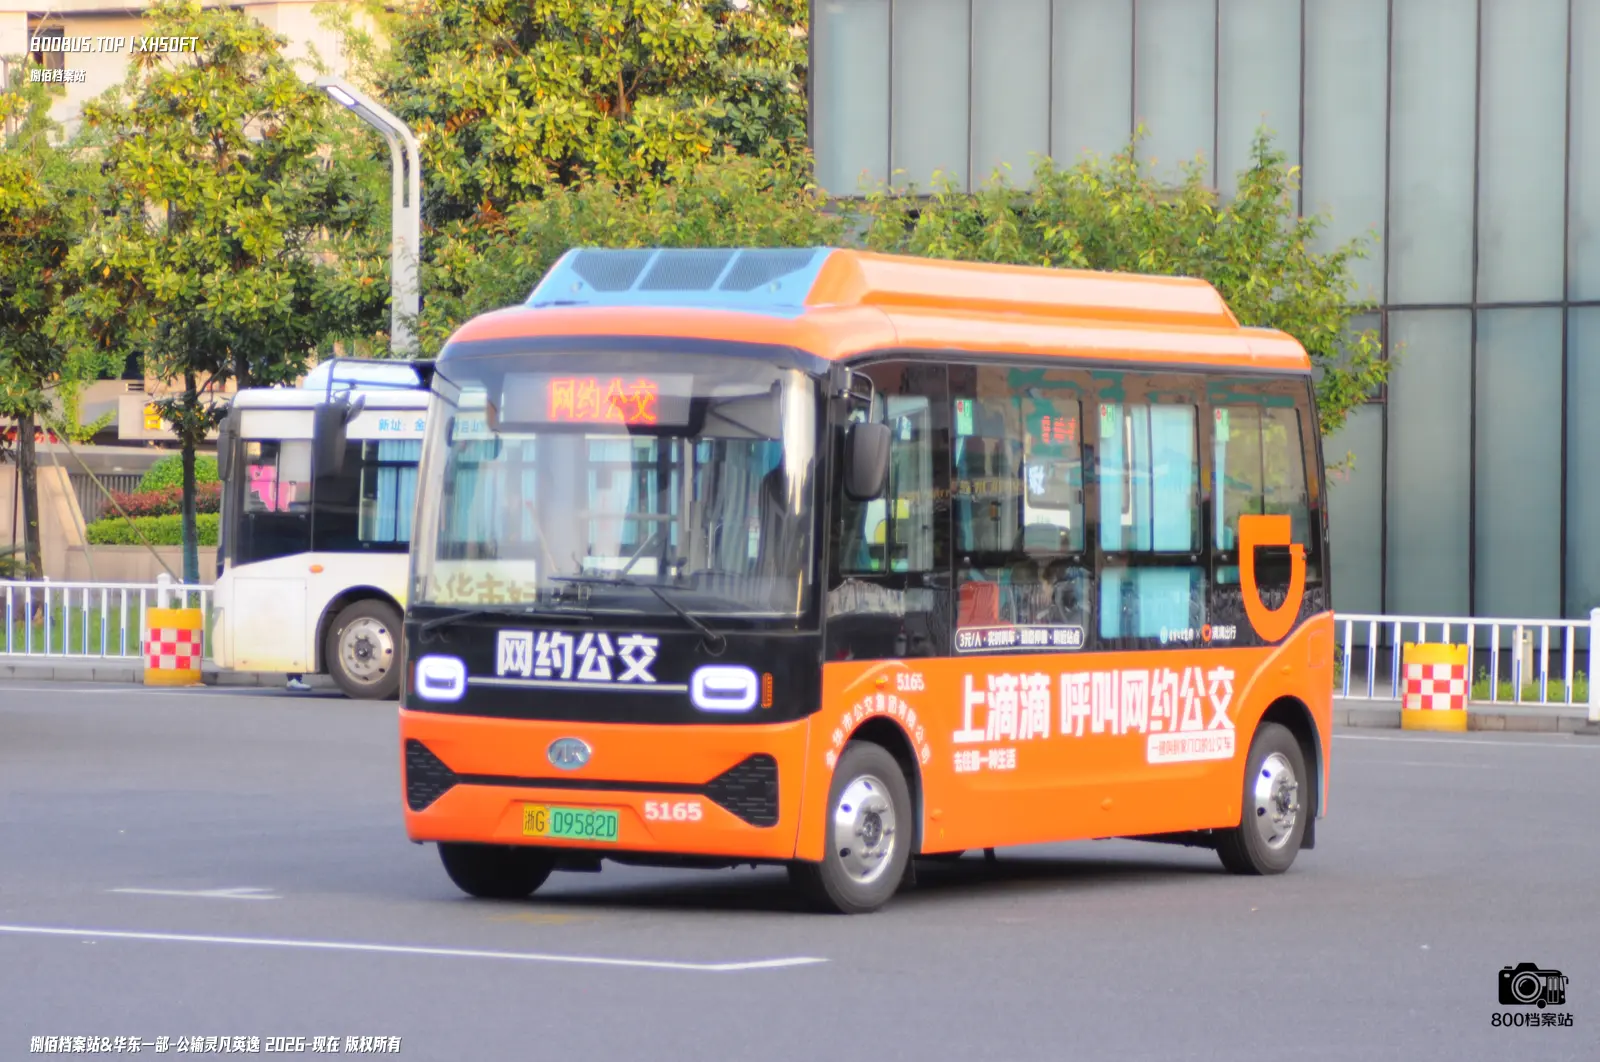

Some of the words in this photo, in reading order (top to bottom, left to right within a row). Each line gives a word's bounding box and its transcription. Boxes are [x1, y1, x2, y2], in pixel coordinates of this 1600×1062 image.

[550, 378, 658, 423] 网约公交
[496, 630, 659, 682] 网约公交
[896, 672, 924, 691] 5165
[953, 672, 1050, 743] 上滴滴
[1060, 666, 1235, 737] 呼叫网约公交
[553, 812, 617, 837] 09582D
[644, 801, 702, 821] 5165
